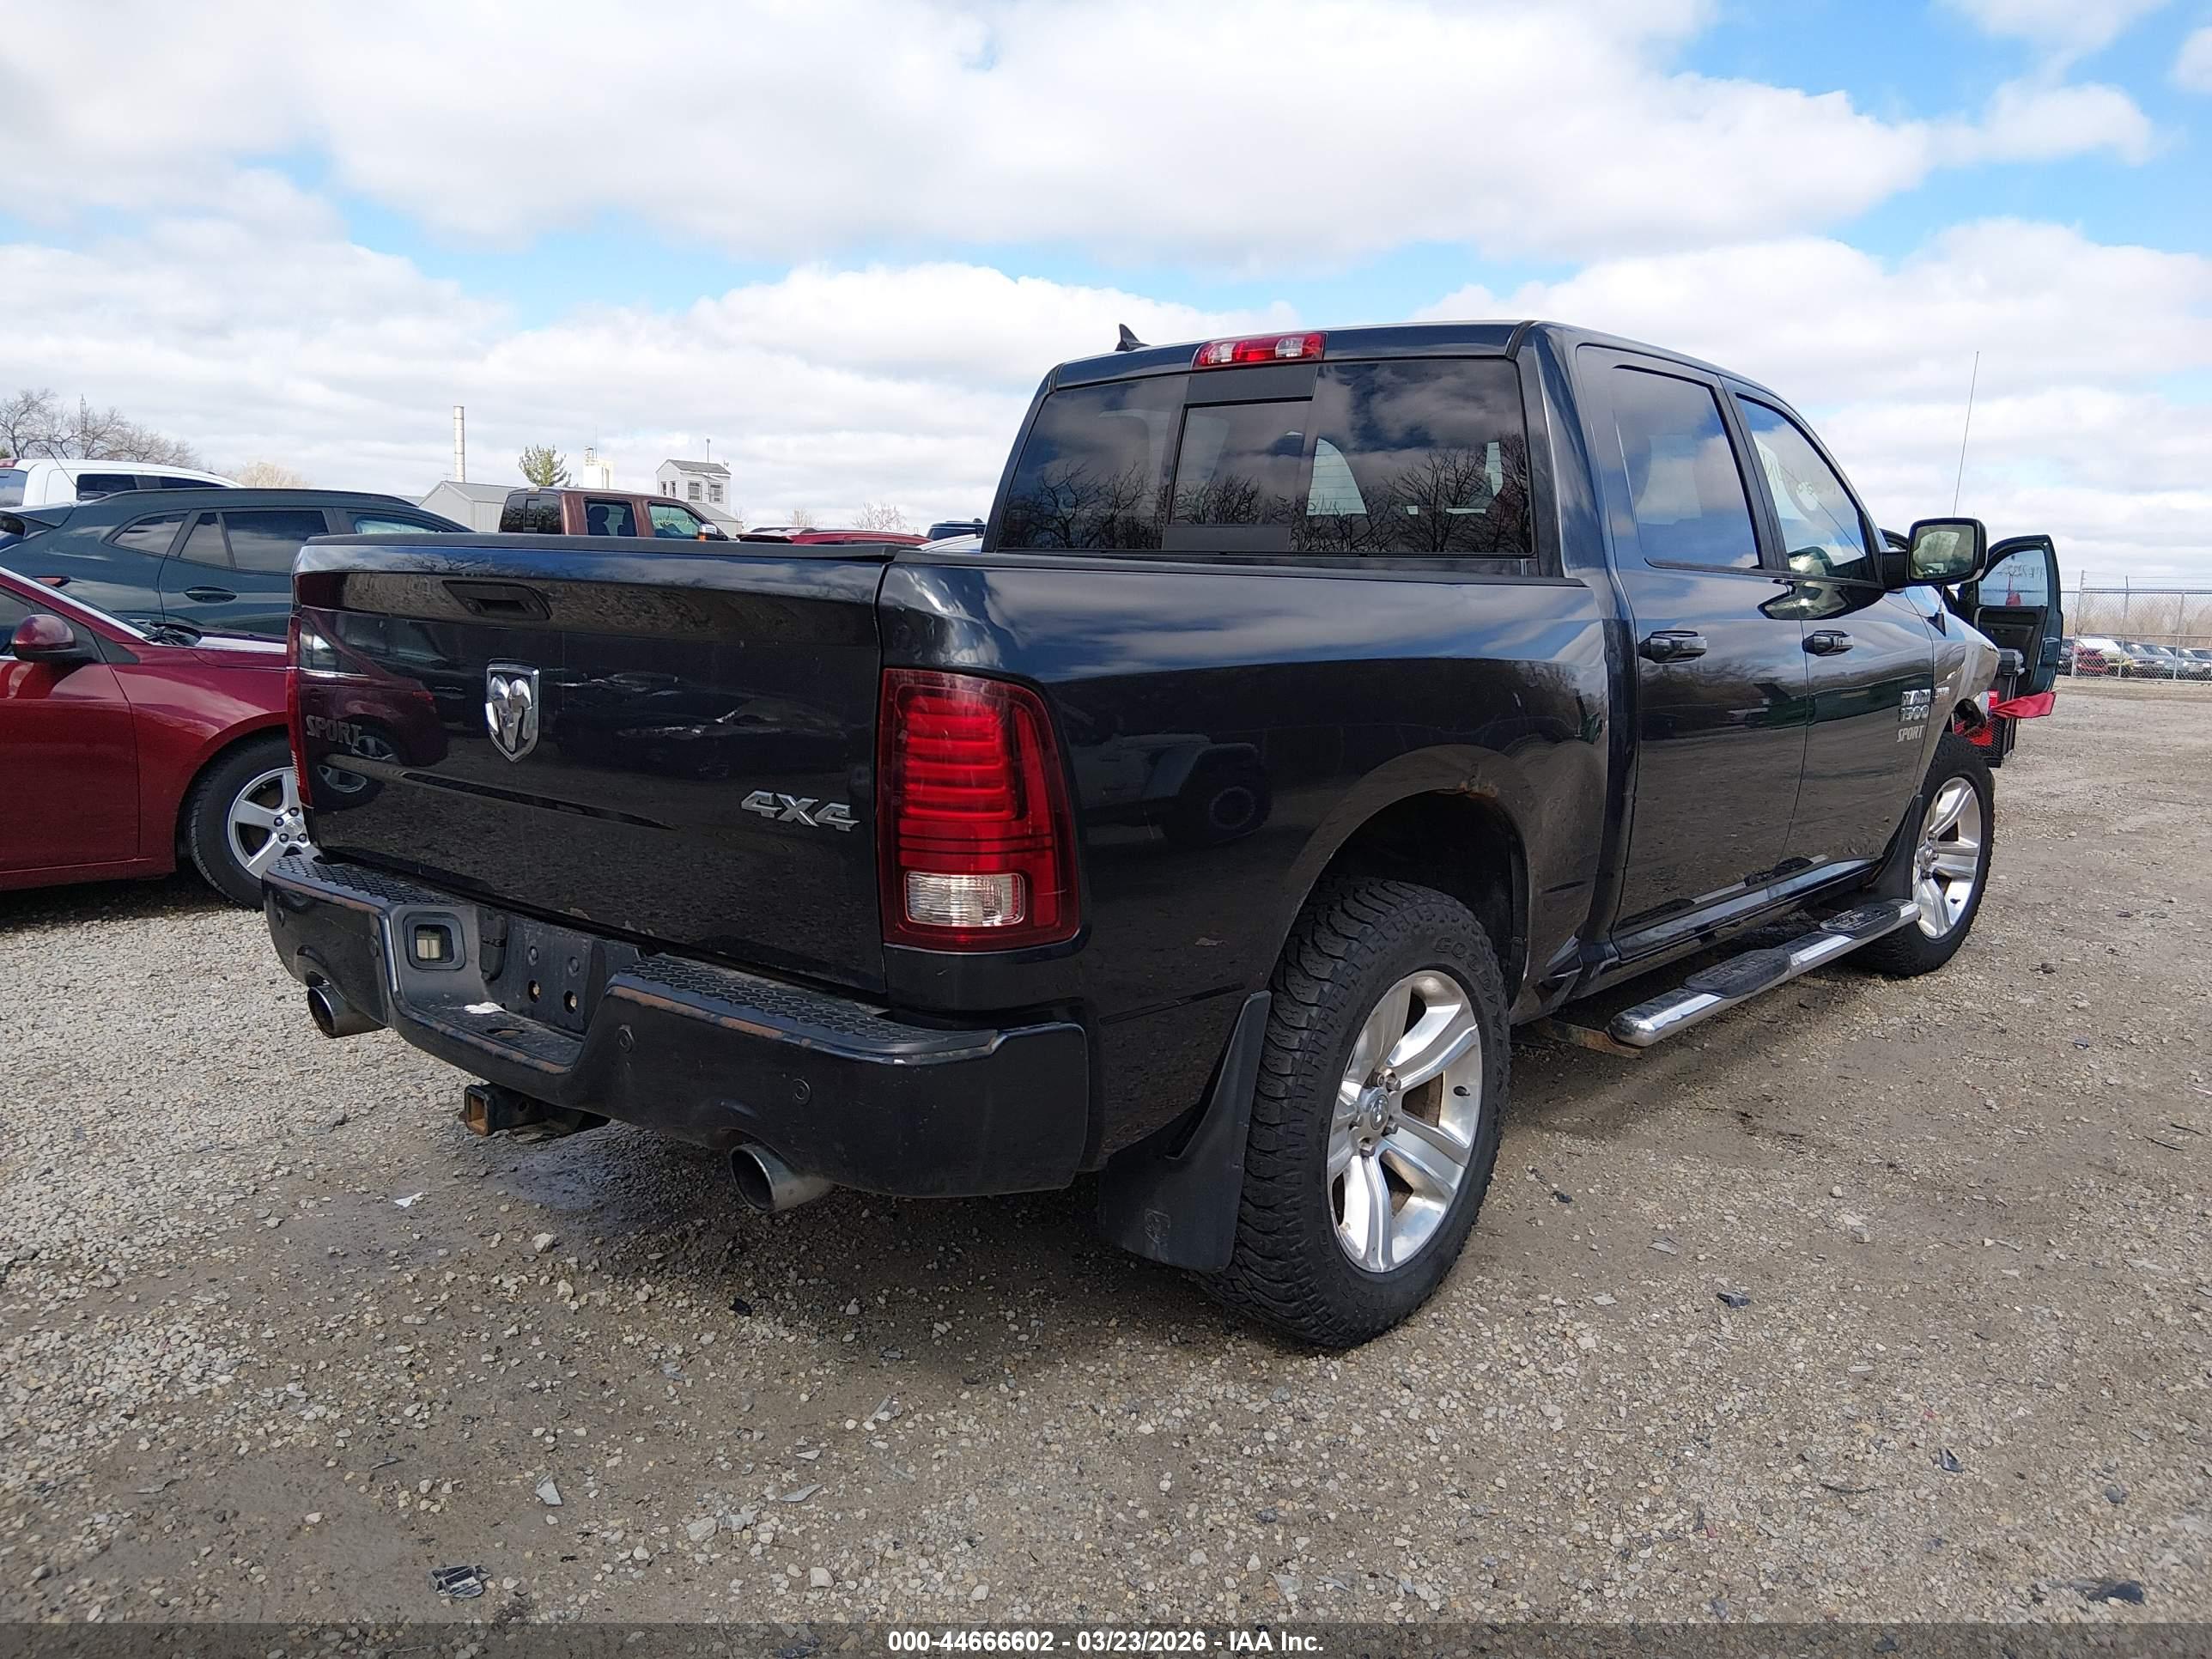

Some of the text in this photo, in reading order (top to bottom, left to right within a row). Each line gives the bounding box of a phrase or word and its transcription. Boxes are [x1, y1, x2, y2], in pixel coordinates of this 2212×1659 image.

[1901, 689, 1931, 706] RAM
[1899, 705, 1929, 721] 1500
[306, 714, 362, 747] SPORT
[1897, 725, 1924, 743] SPORT
